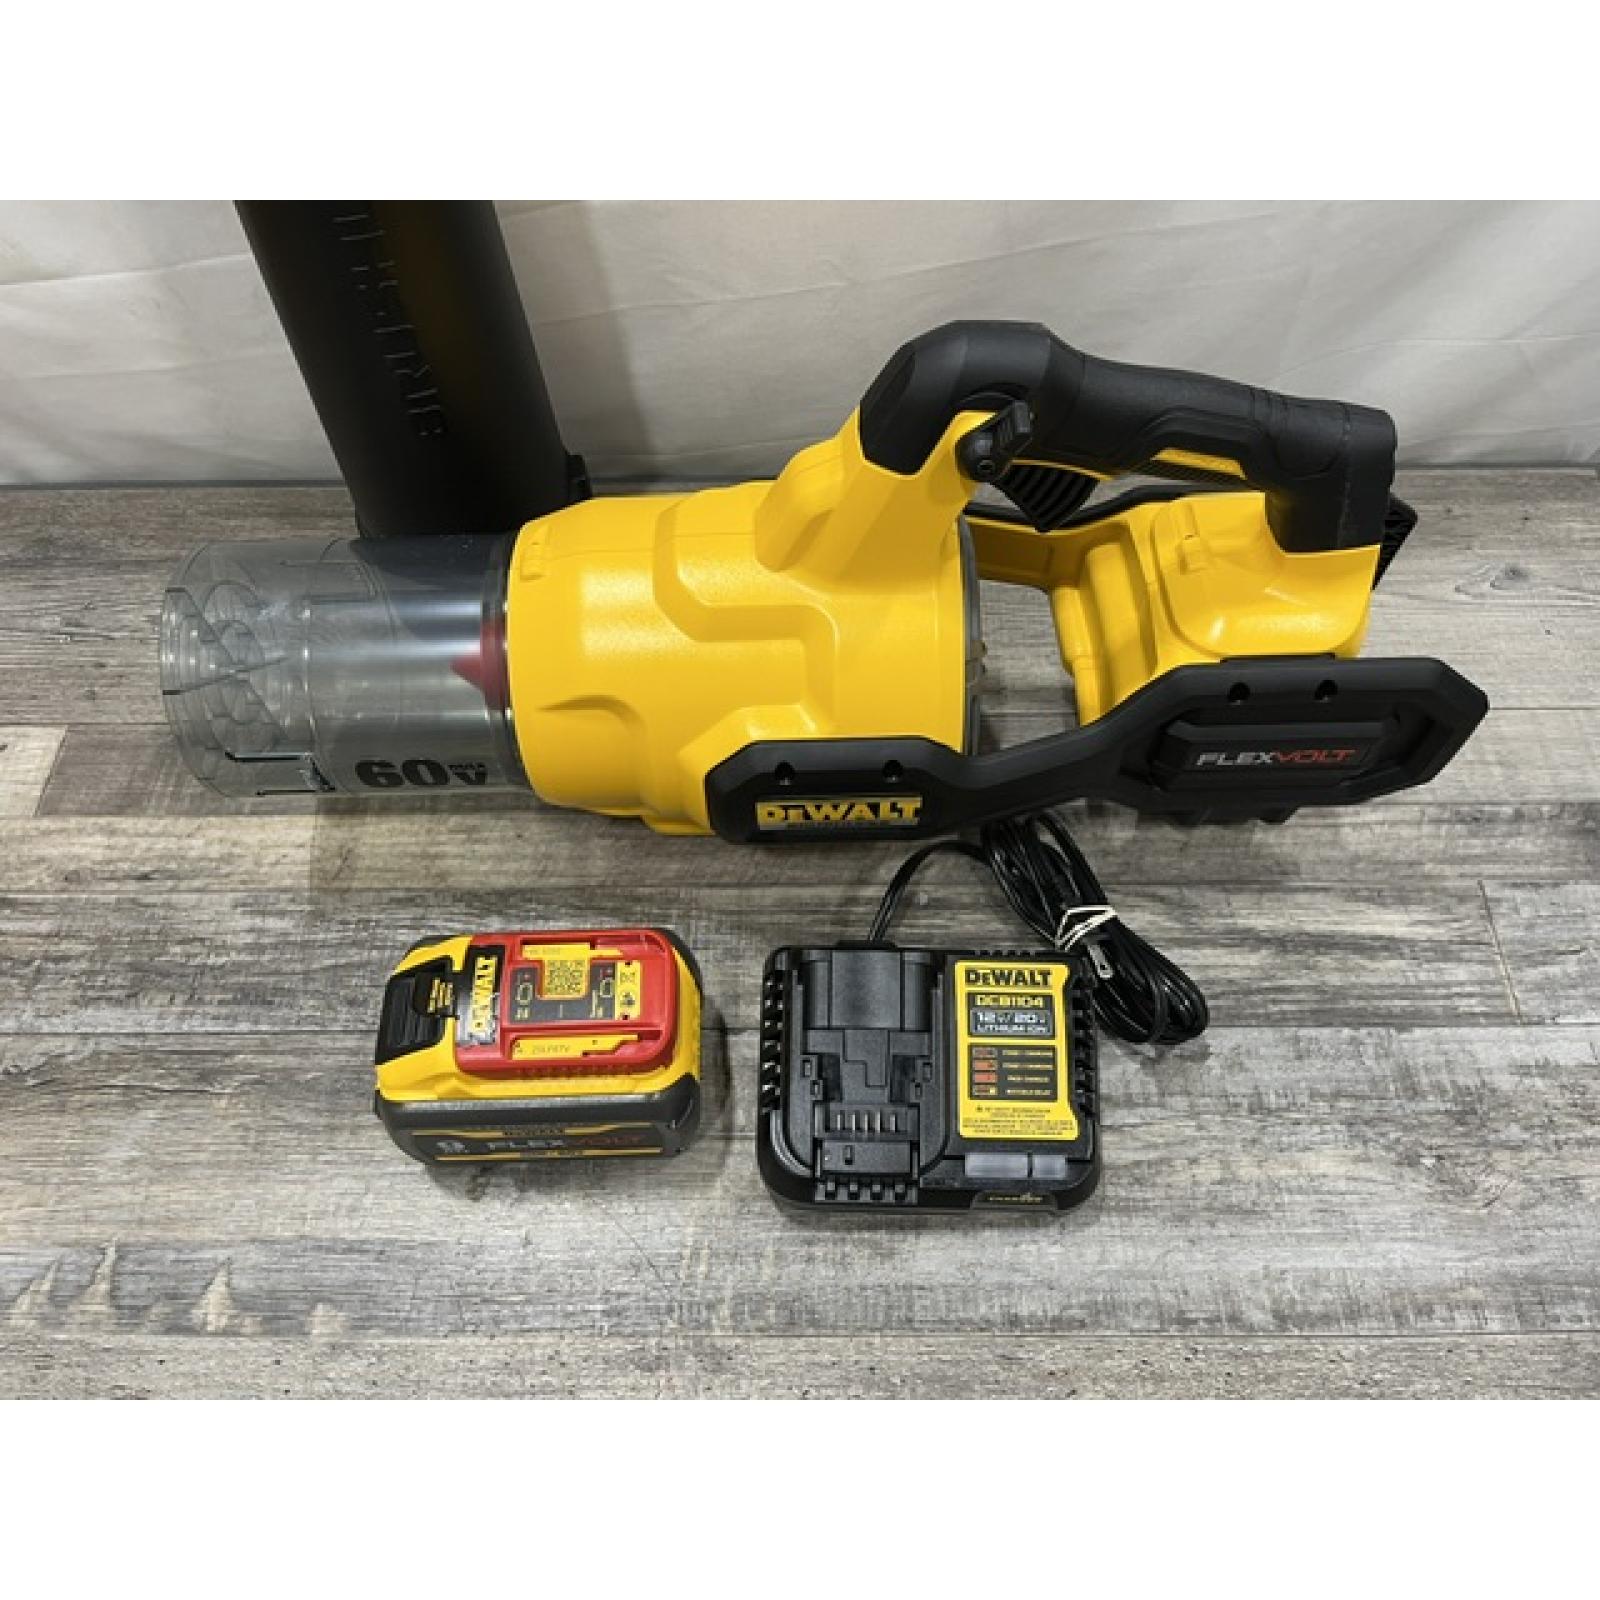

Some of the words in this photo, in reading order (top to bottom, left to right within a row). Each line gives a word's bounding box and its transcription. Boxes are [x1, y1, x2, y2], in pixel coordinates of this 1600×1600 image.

[1196, 748, 1356, 767] FLEXVOLT
[756, 797, 922, 827] DEWALT
[965, 968, 1051, 986] DEWALT
